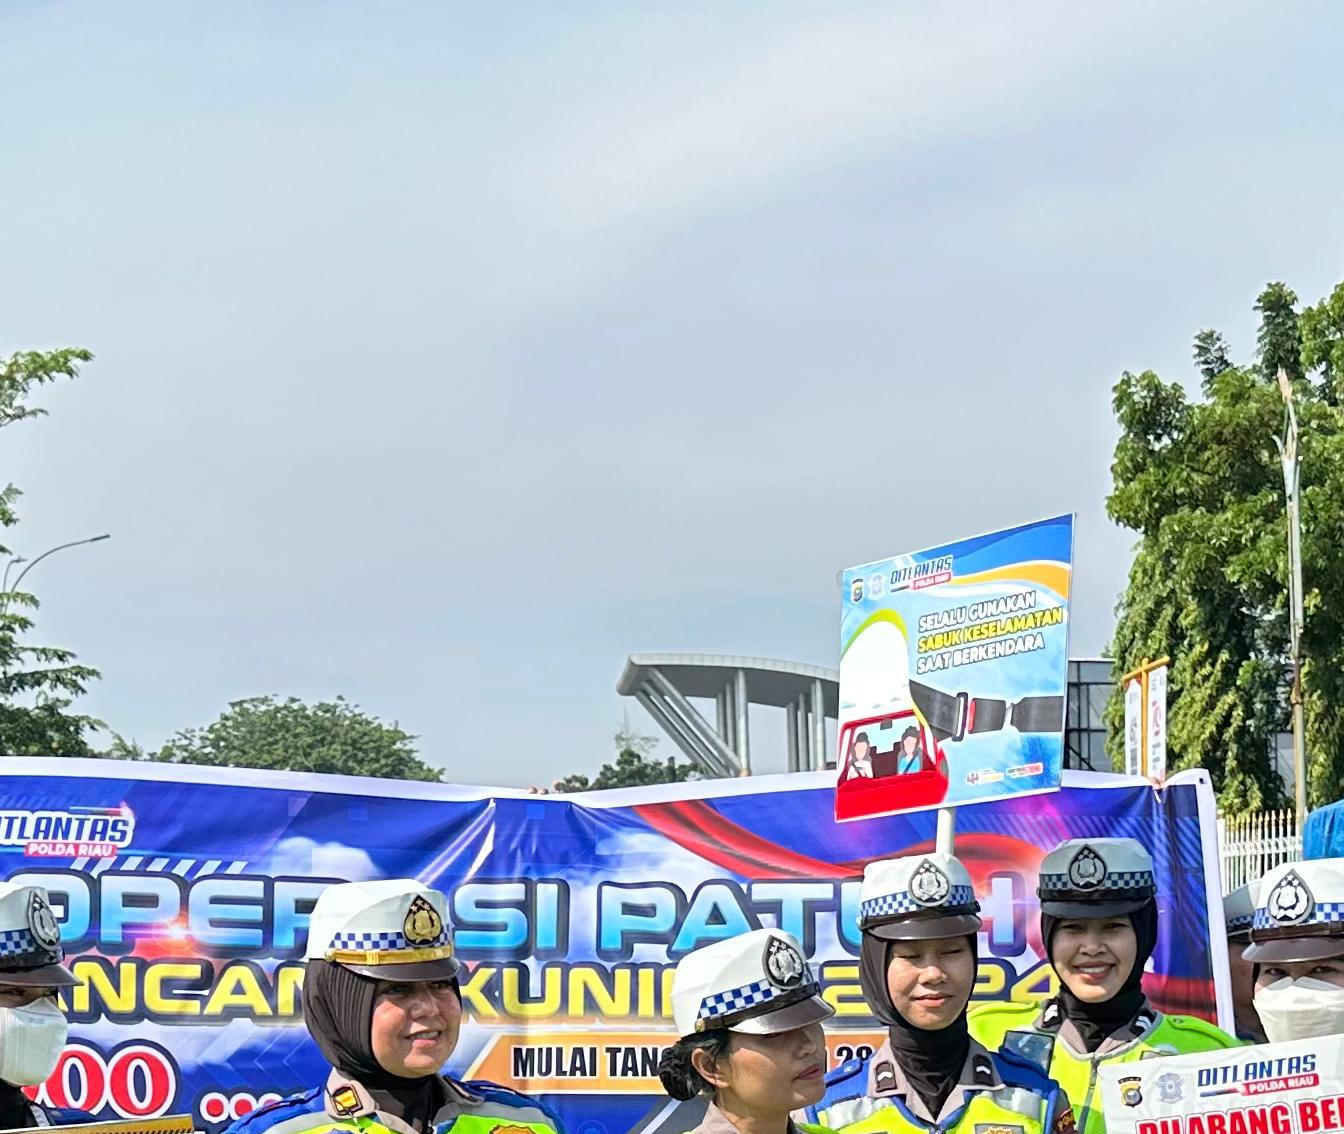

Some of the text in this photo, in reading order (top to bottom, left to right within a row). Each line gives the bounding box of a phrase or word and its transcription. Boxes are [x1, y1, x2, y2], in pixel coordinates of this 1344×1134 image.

[890, 556, 952, 584] DITLANTAS
[918, 590, 1036, 633] SELALU GUNAKAN
[918, 607, 1064, 654] SABUK KESELAMATAN
[917, 632, 1045, 674] SAAT BERKENDARA
[29, 844, 112, 857] POLDA RIAU
[513, 1047, 597, 1077] MULAI
[605, 1047, 659, 1077] TAN
[1197, 1054, 1316, 1087] DITLANTAS
[1249, 1076, 1314, 1094] POLDA RIAU
